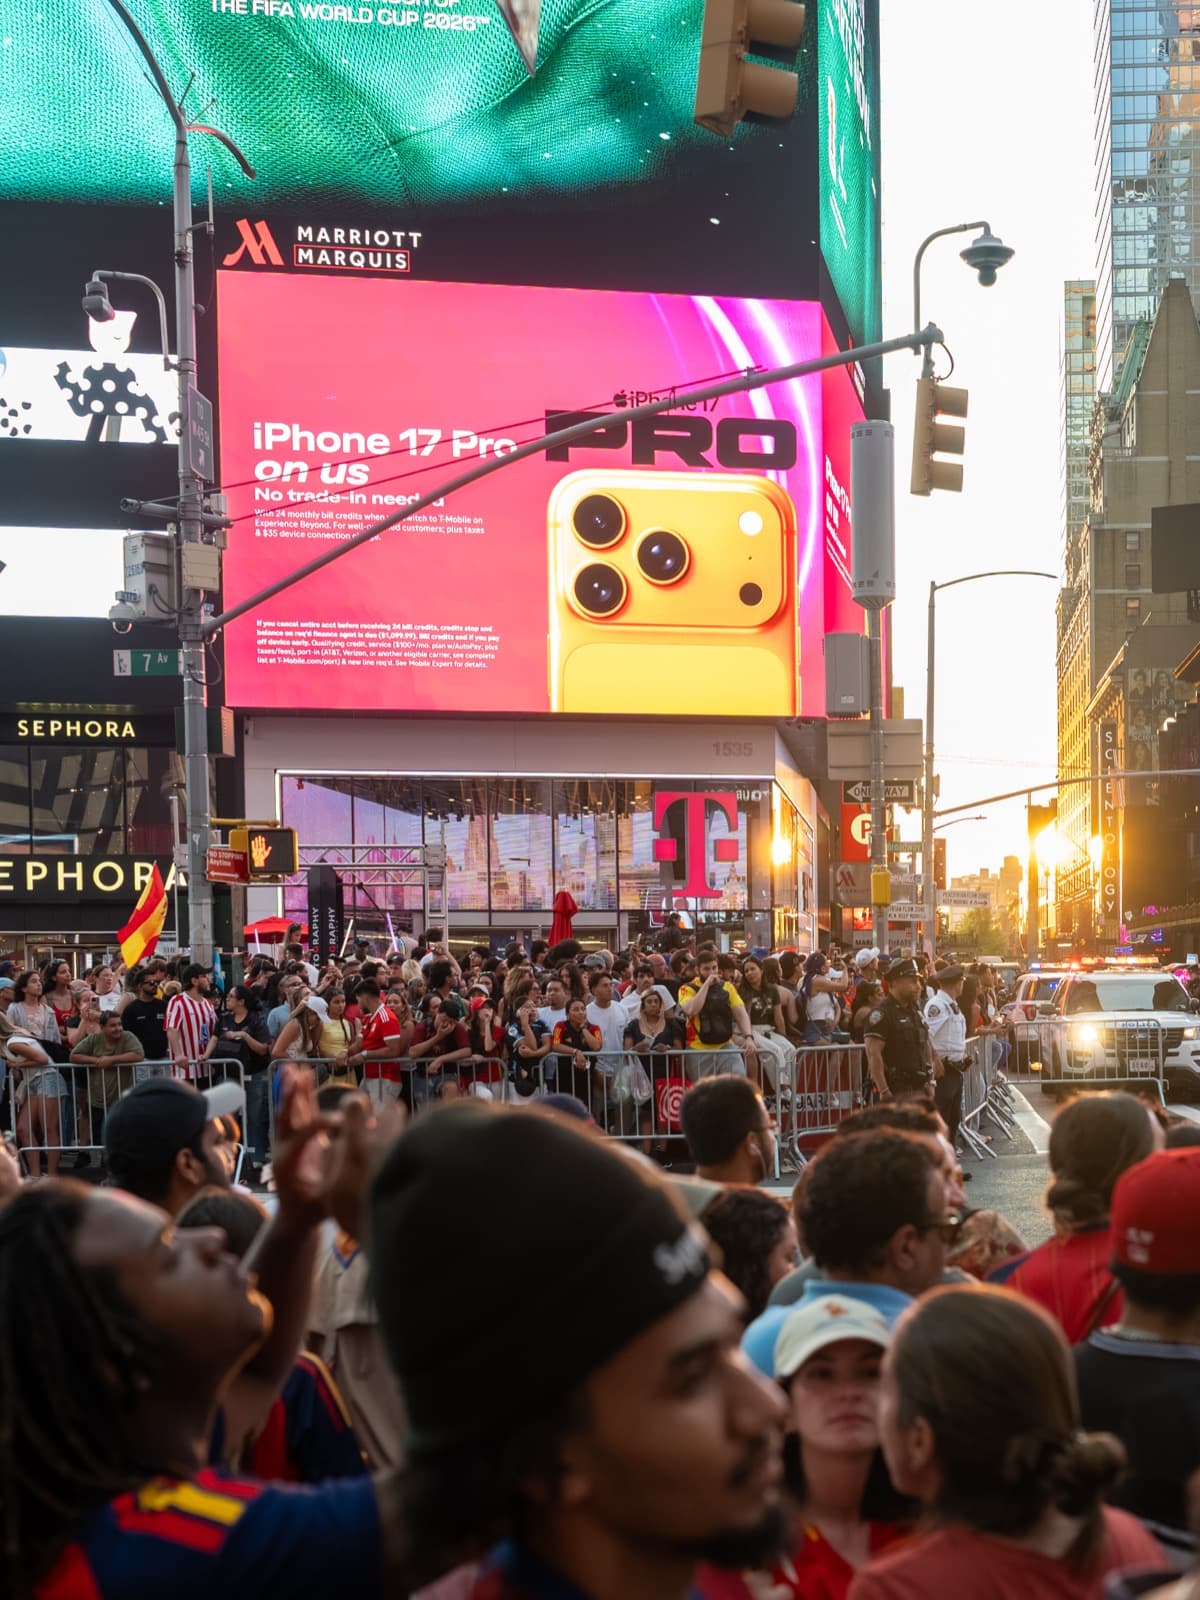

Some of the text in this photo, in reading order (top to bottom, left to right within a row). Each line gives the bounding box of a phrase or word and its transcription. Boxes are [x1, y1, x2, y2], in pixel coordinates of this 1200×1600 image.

[211, 0, 249, 15] THE
[252, 0, 294, 18] FIFA
[301, 3, 374, 24] WORLD
[378, 9, 420, 26] CUP
[297, 226, 422, 248] MARRIOTT
[298, 248, 408, 269] MARQUIS
[253, 422, 518, 459] iPhone 17 Pro
[545, 409, 797, 471] PRO
[254, 460, 370, 485] on us
[254, 487, 444, 508] No trade-in needd
[255, 519, 298, 528] Experience
[300, 520, 332, 530] Beyond.
[402, 525, 445, 534] customers;
[446, 526, 462, 534] plus
[464, 526, 485, 534] taxes
[288, 510, 320, 520] monthly
[321, 510, 334, 519] bill
[336, 512, 362, 520] credits
[364, 512, 385, 520] when
[438, 515, 471, 524] T-Mobile
[473, 516, 483, 524] on
[263, 528, 278, 538] $35
[279, 530, 306, 538] device
[306, 531, 350, 540] connection
[312, 640, 344, 649] Qualifying
[142, 652, 168, 673] 7 Av
[17, 720, 136, 738] SEPHORA
[884, 786, 905, 798] WAY
[1104, 731, 1116, 913] SCIENTOLOGY
[208, 850, 244, 860] NO STOPPING
[210, 858, 231, 867] Anytime
